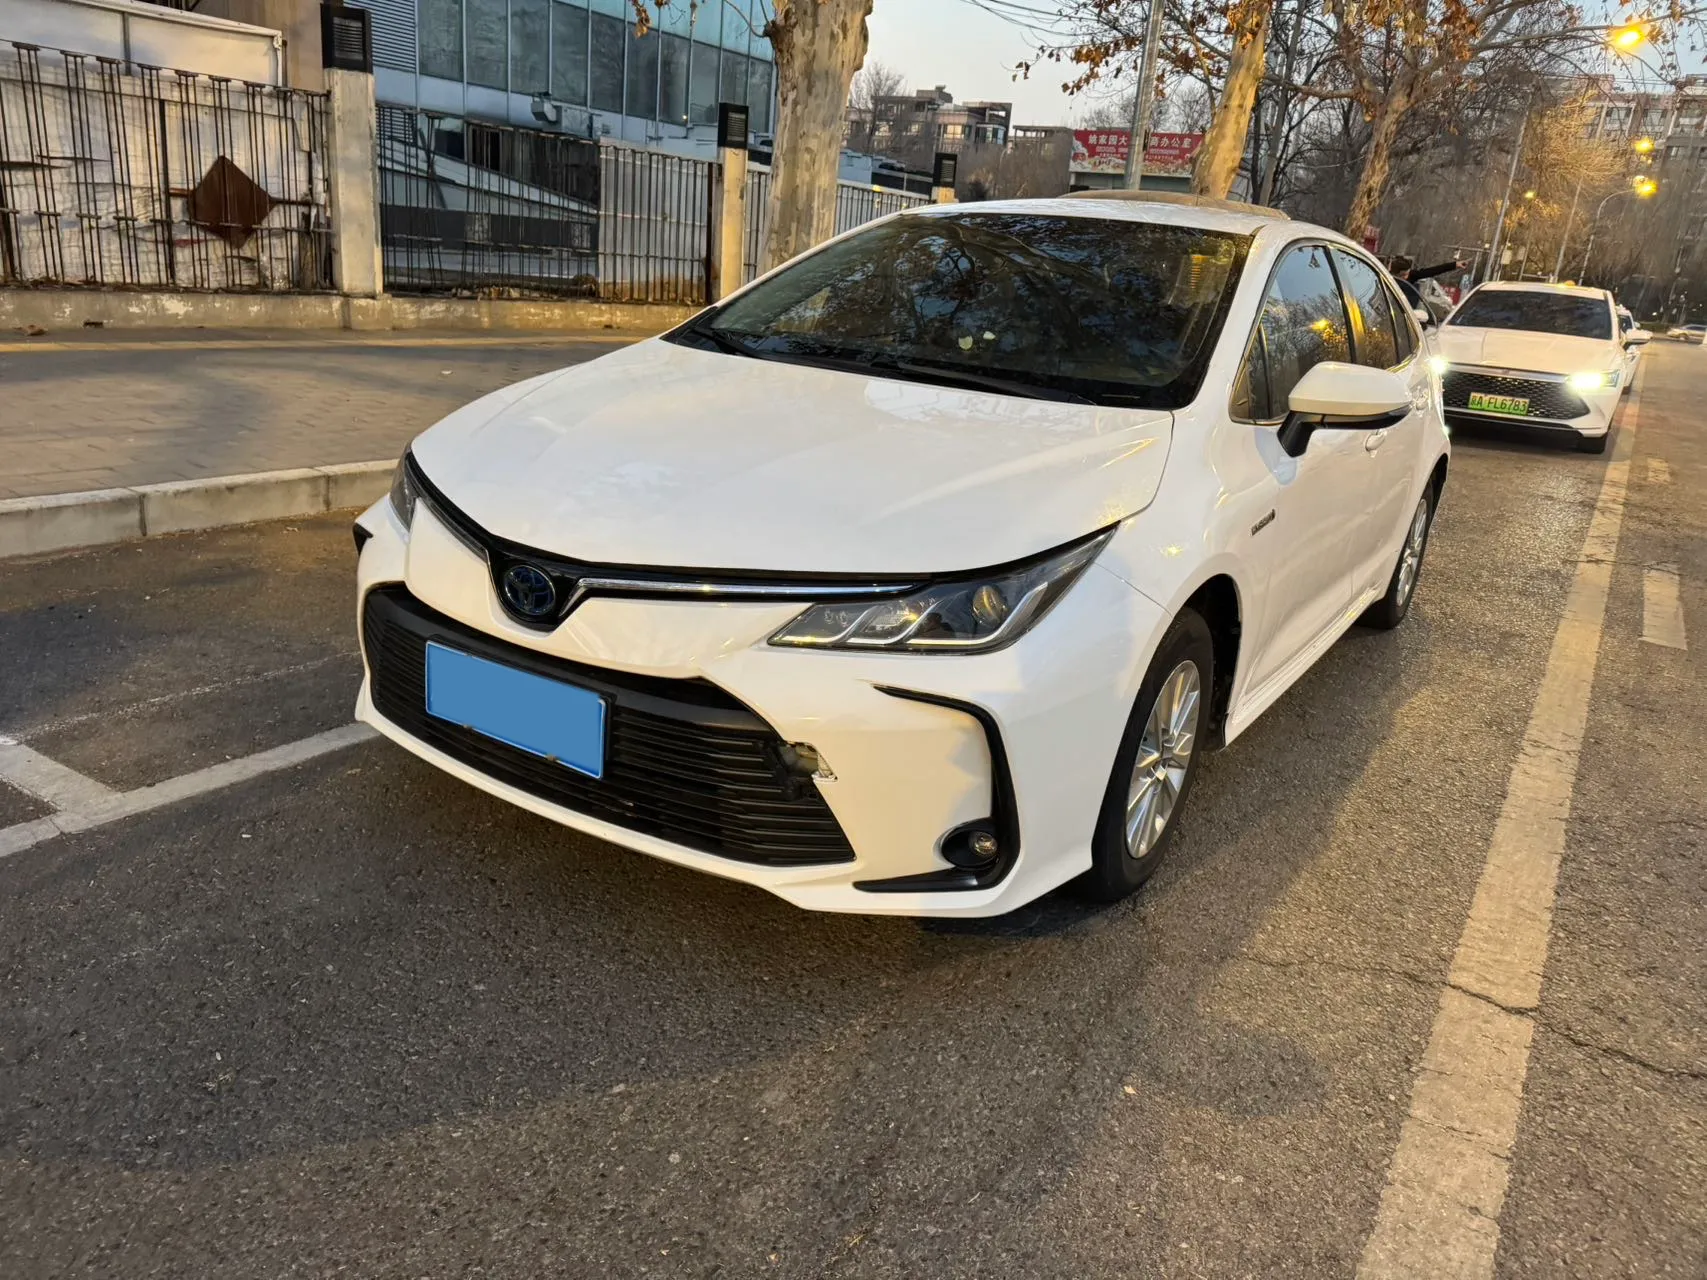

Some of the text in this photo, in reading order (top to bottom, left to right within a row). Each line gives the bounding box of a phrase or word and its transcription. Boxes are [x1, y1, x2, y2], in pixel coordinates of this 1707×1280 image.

[1088, 134, 1192, 149] 姚家园大商办公室
